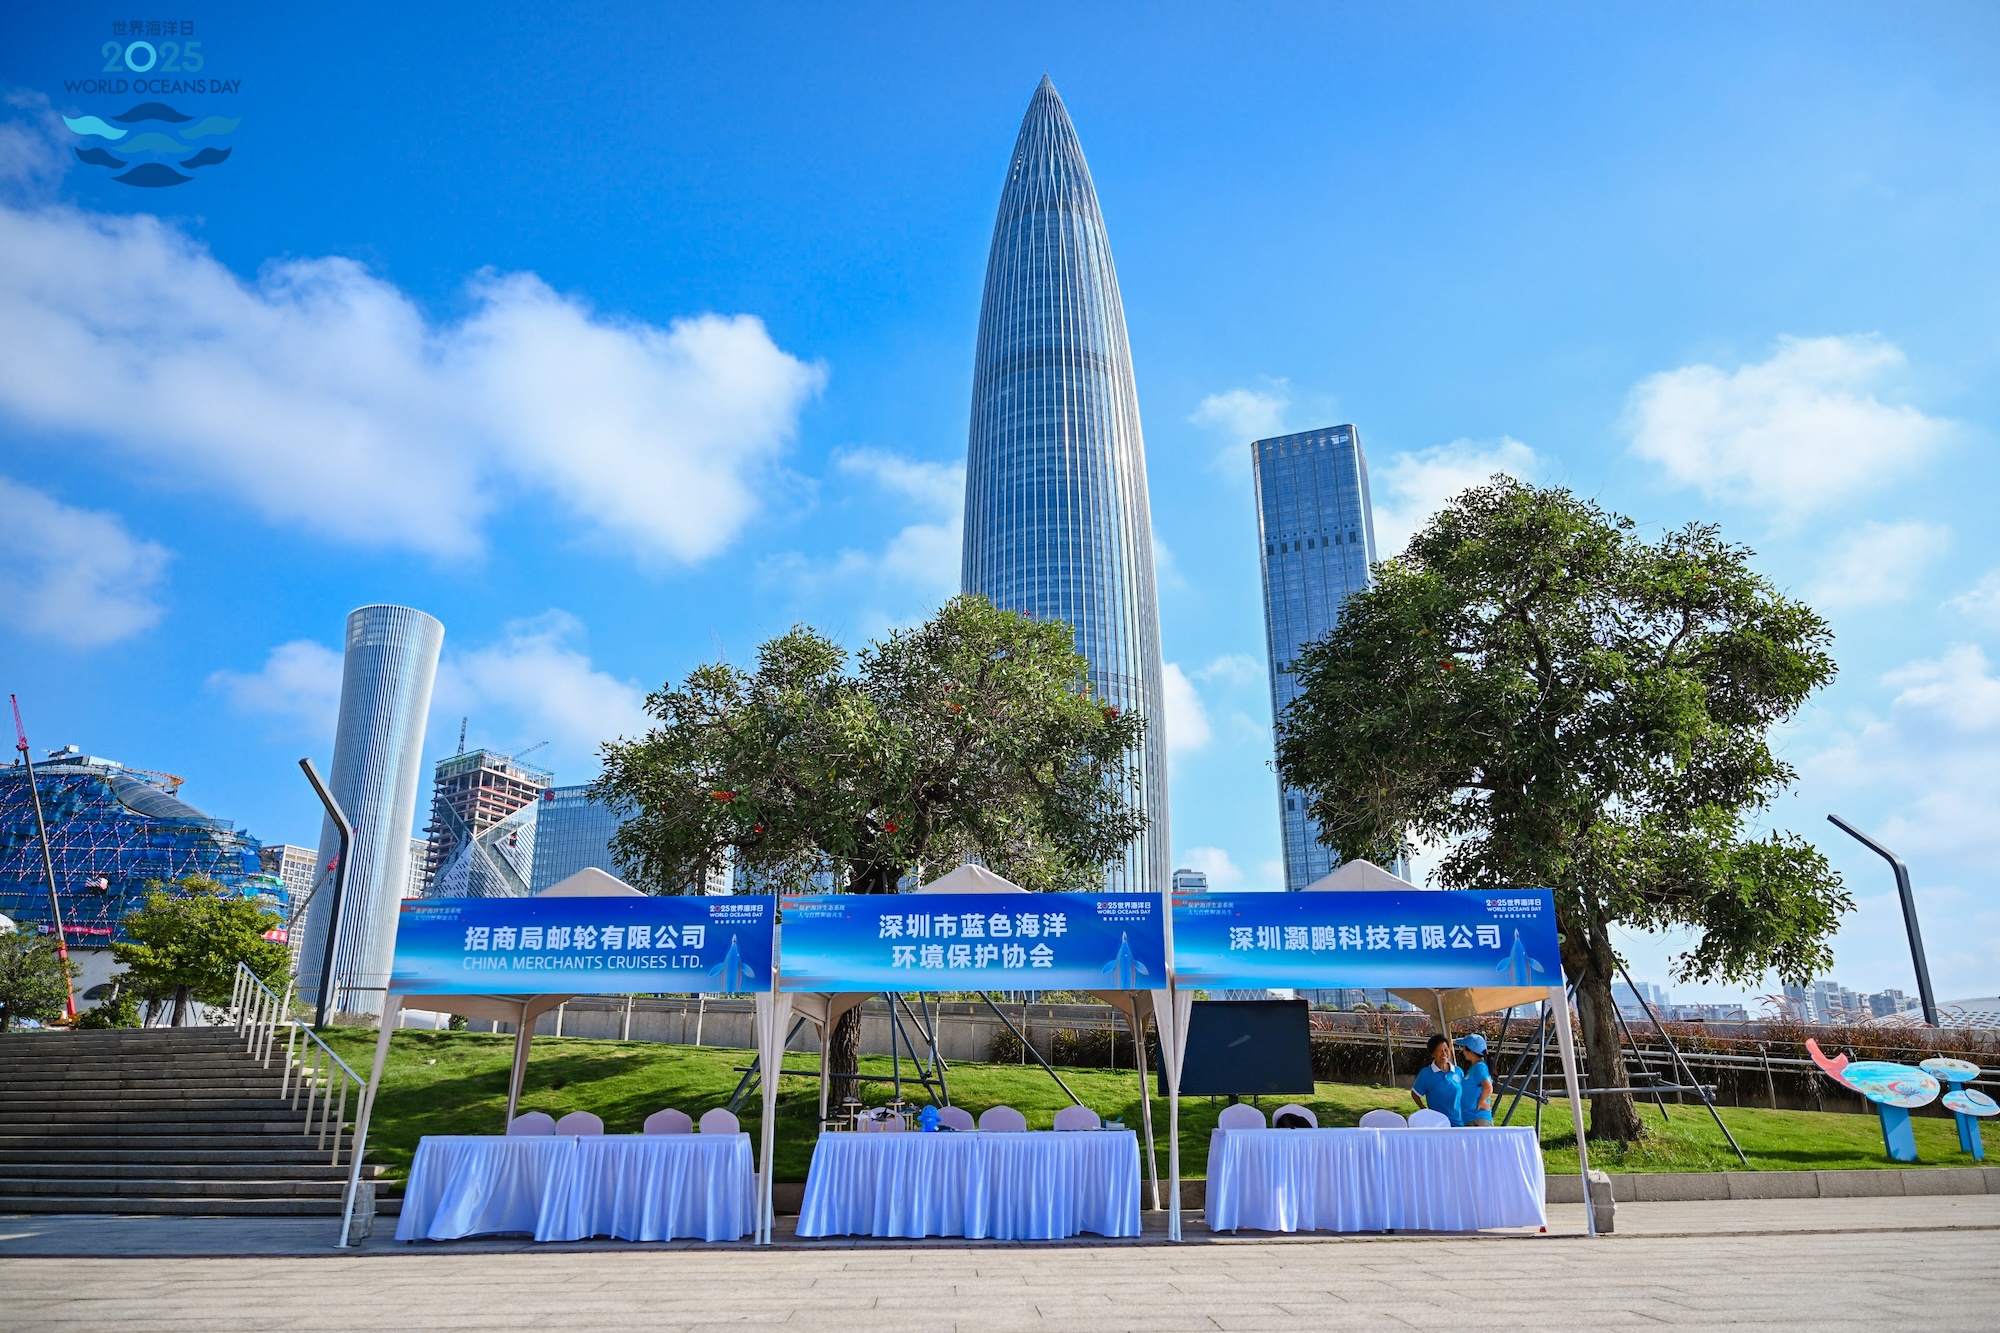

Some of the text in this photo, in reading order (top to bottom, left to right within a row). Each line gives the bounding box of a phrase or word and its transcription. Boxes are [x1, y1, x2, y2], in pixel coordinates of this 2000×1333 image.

[464, 925, 705, 951] 招商局邮轮有限公司
[878, 912, 1067, 939] 深圳市蓝色海洋
[1229, 924, 1502, 951] 深圳灏鹏科技有限公司
[463, 954, 703, 970] CHINA MERCHANTS CRUISES LTD.
[892, 943, 1054, 969] 环境保护协会
